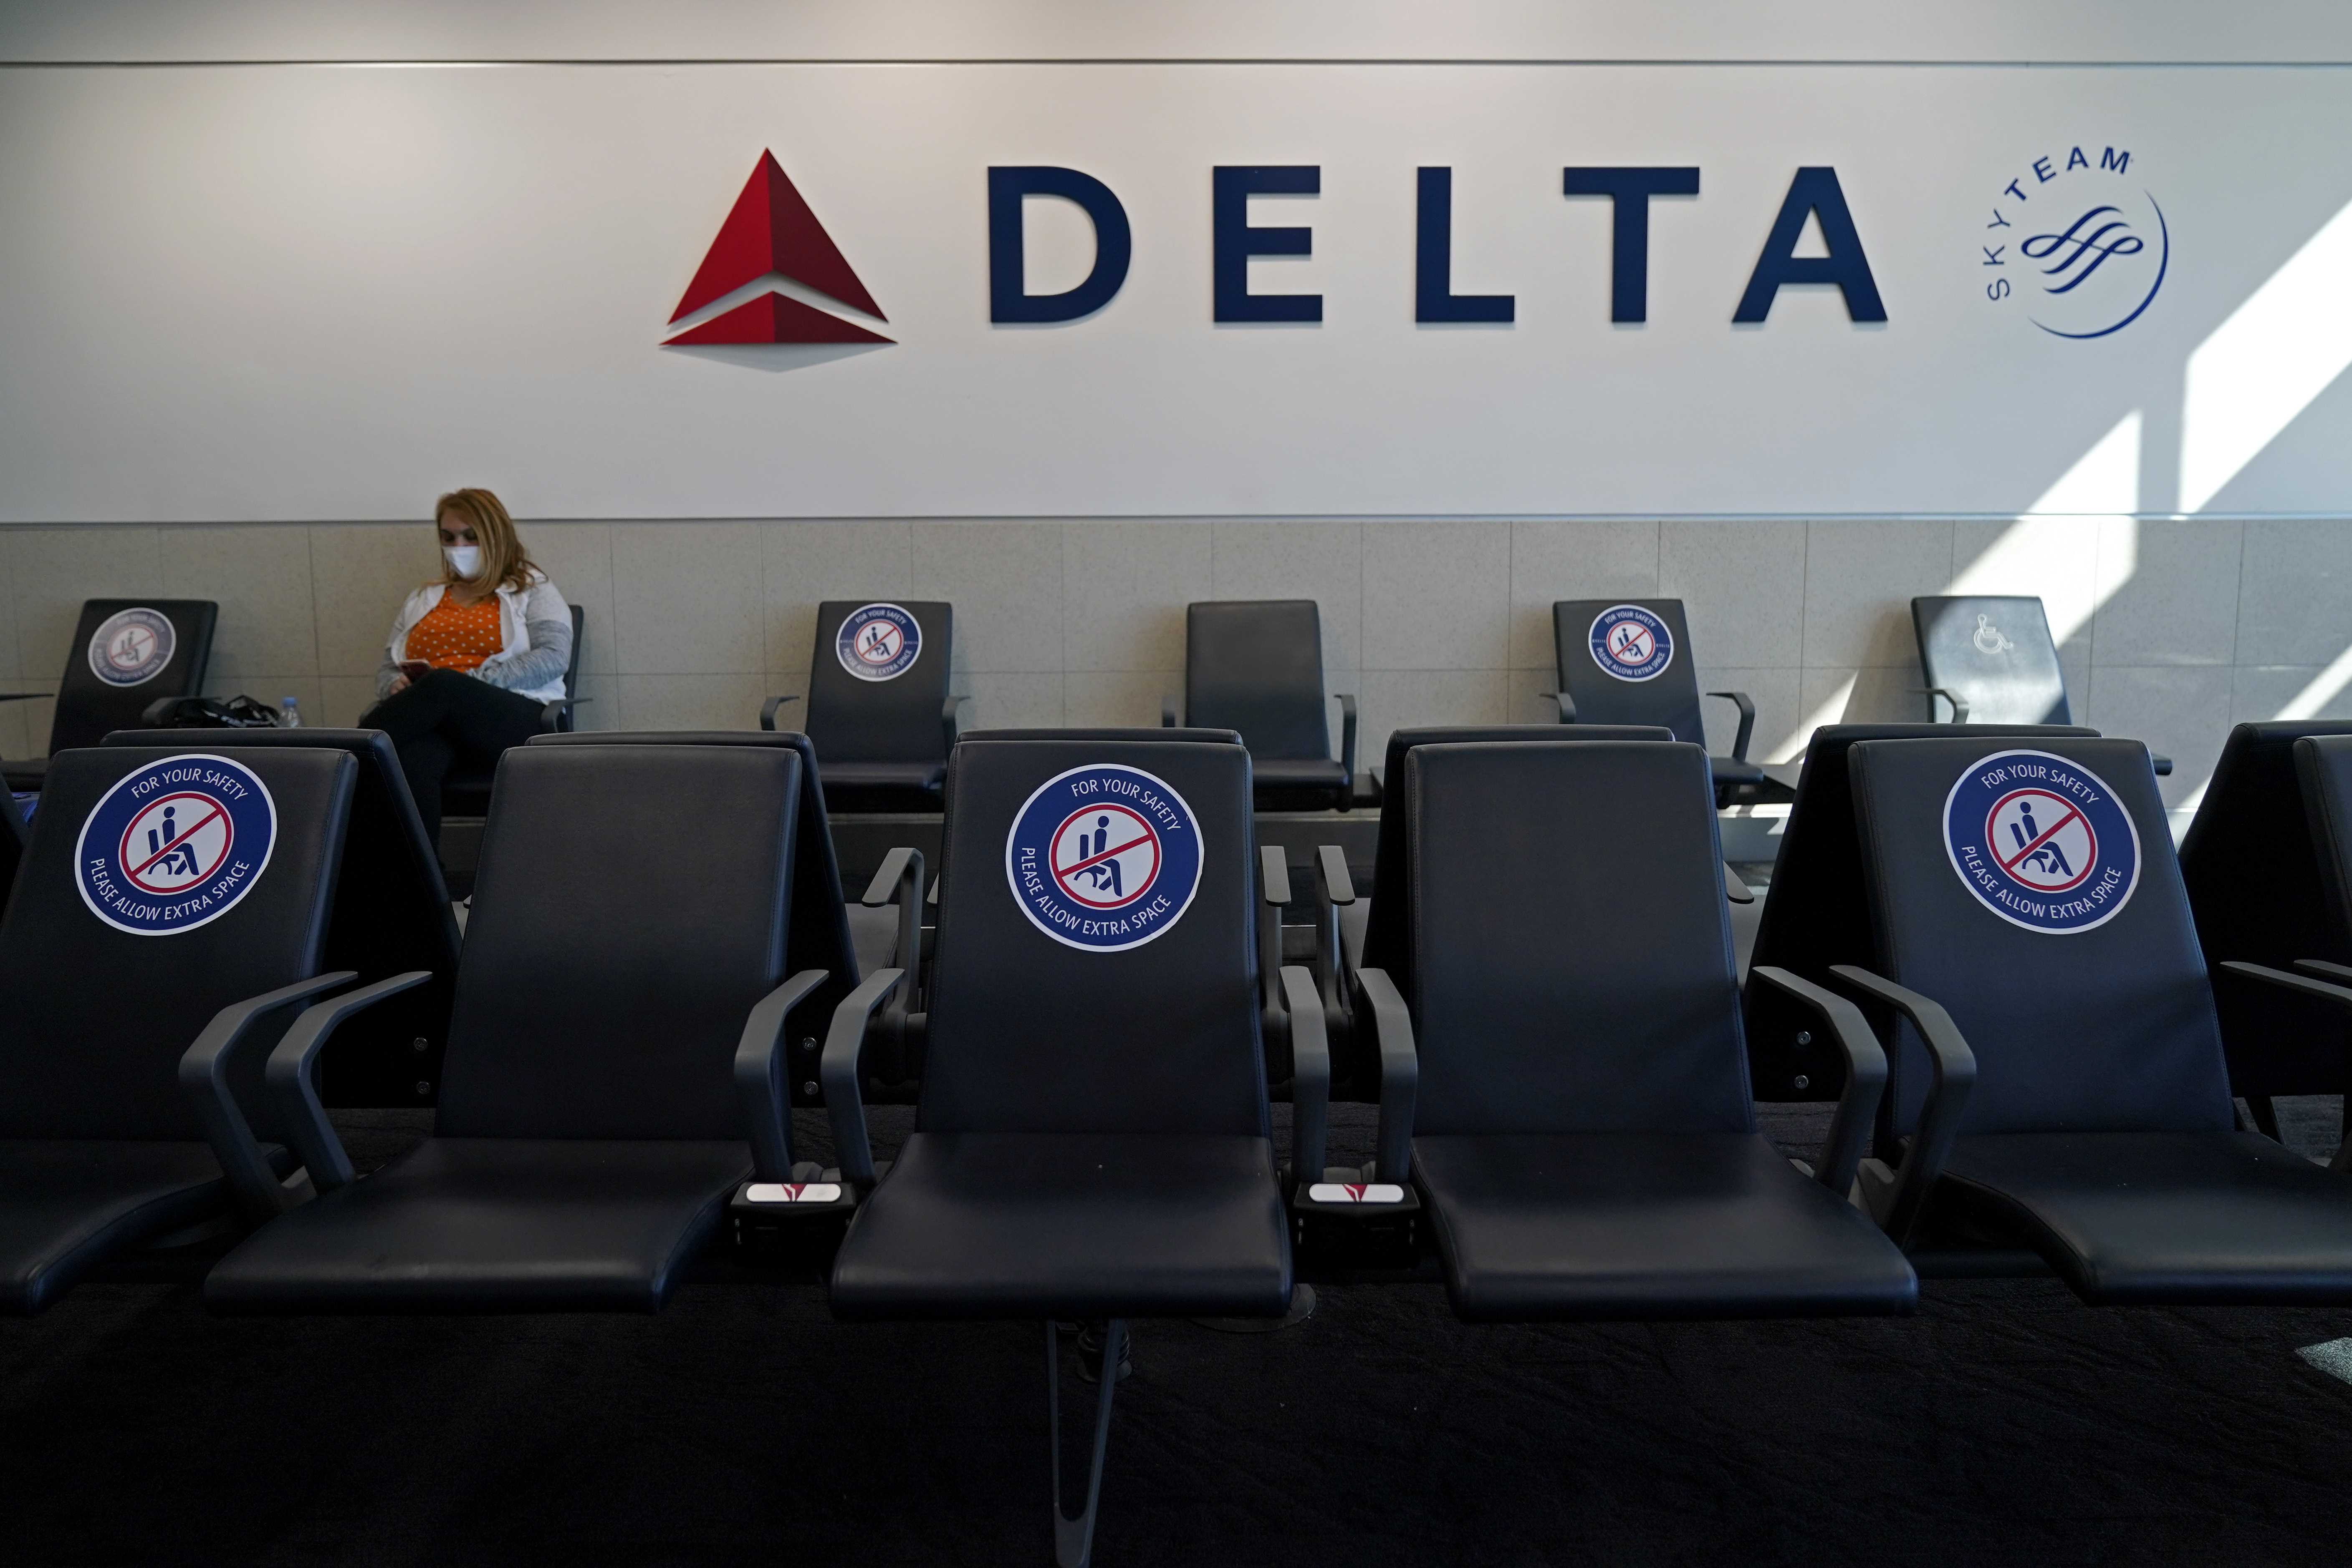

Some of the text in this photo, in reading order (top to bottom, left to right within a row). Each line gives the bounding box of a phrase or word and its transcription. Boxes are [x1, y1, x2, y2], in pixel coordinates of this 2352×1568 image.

[987, 165, 1888, 323] DELTA
[868, 609, 885, 618] YOUR
[887, 610, 907, 625] SAFETY
[1604, 611, 1657, 628] FOR YOUR SAFETY
[1596, 647, 1666, 676] PLEASE ALLOW EXTRA SPACE
[131, 768, 248, 800] FOR YOUR SAFETY
[1071, 779, 1181, 830] FOR YOUR SAFETY
[1981, 765, 2099, 804] FOR YOUR SAFETY
[91, 858, 250, 920] PLEASE ALLOW EXTRA SPACE
[1022, 848, 1171, 935] PLEASE ALLOW EXTRA SPACE
[1962, 846, 2121, 919] PLEASE ALLOW EXTRA SPACE
